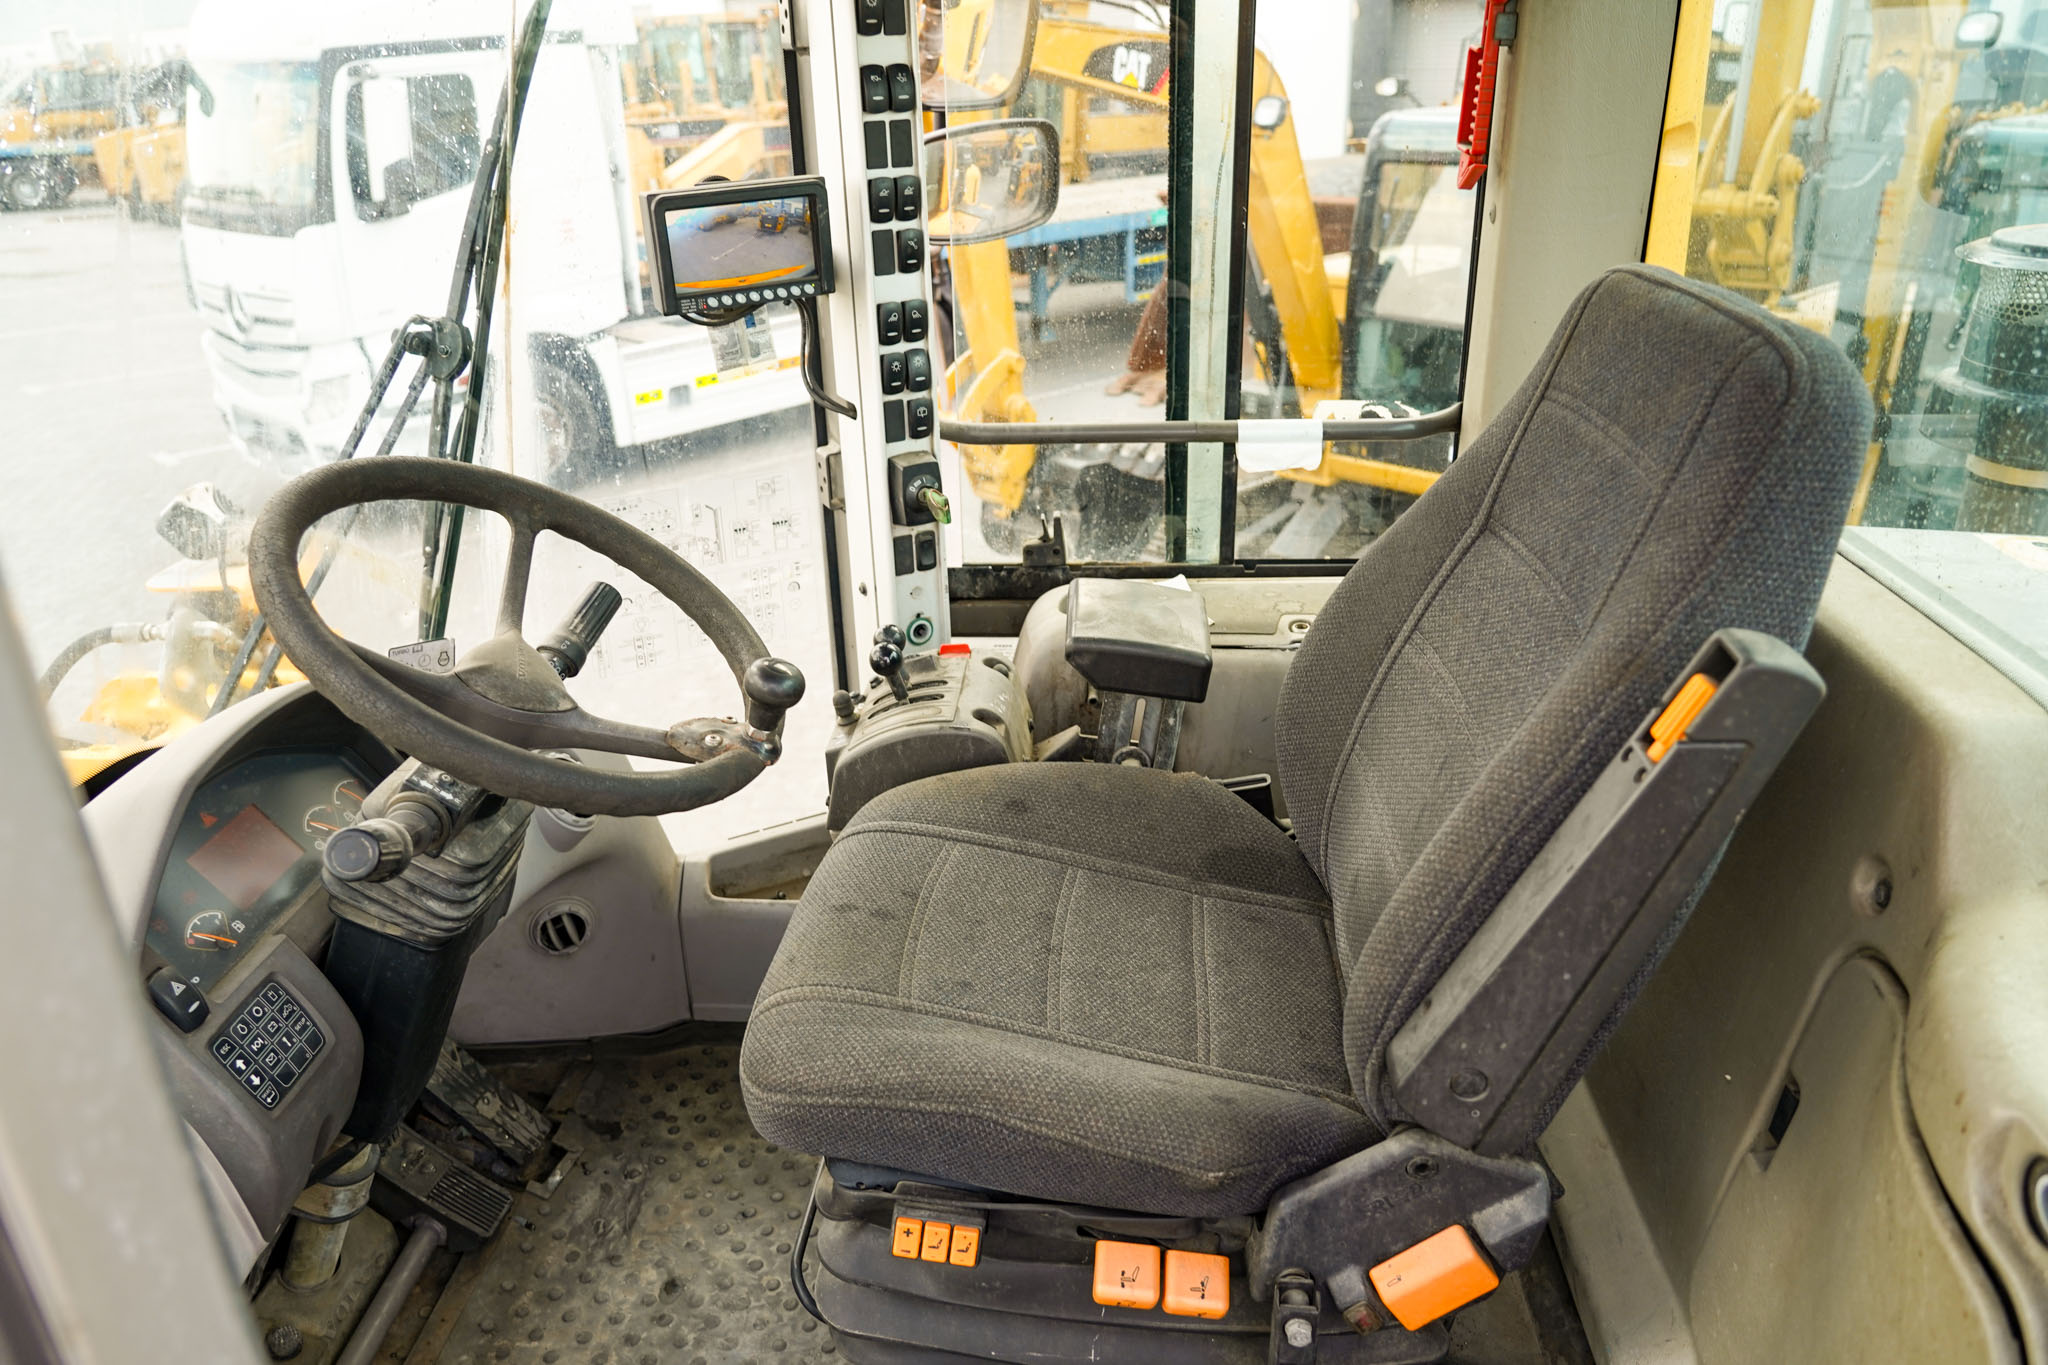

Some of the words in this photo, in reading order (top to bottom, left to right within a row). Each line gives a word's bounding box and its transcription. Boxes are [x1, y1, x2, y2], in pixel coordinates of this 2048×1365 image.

[1112, 46, 1152, 91] CAT
[294, 1017, 307, 1032] SETUP
[220, 1043, 232, 1055] ESC
